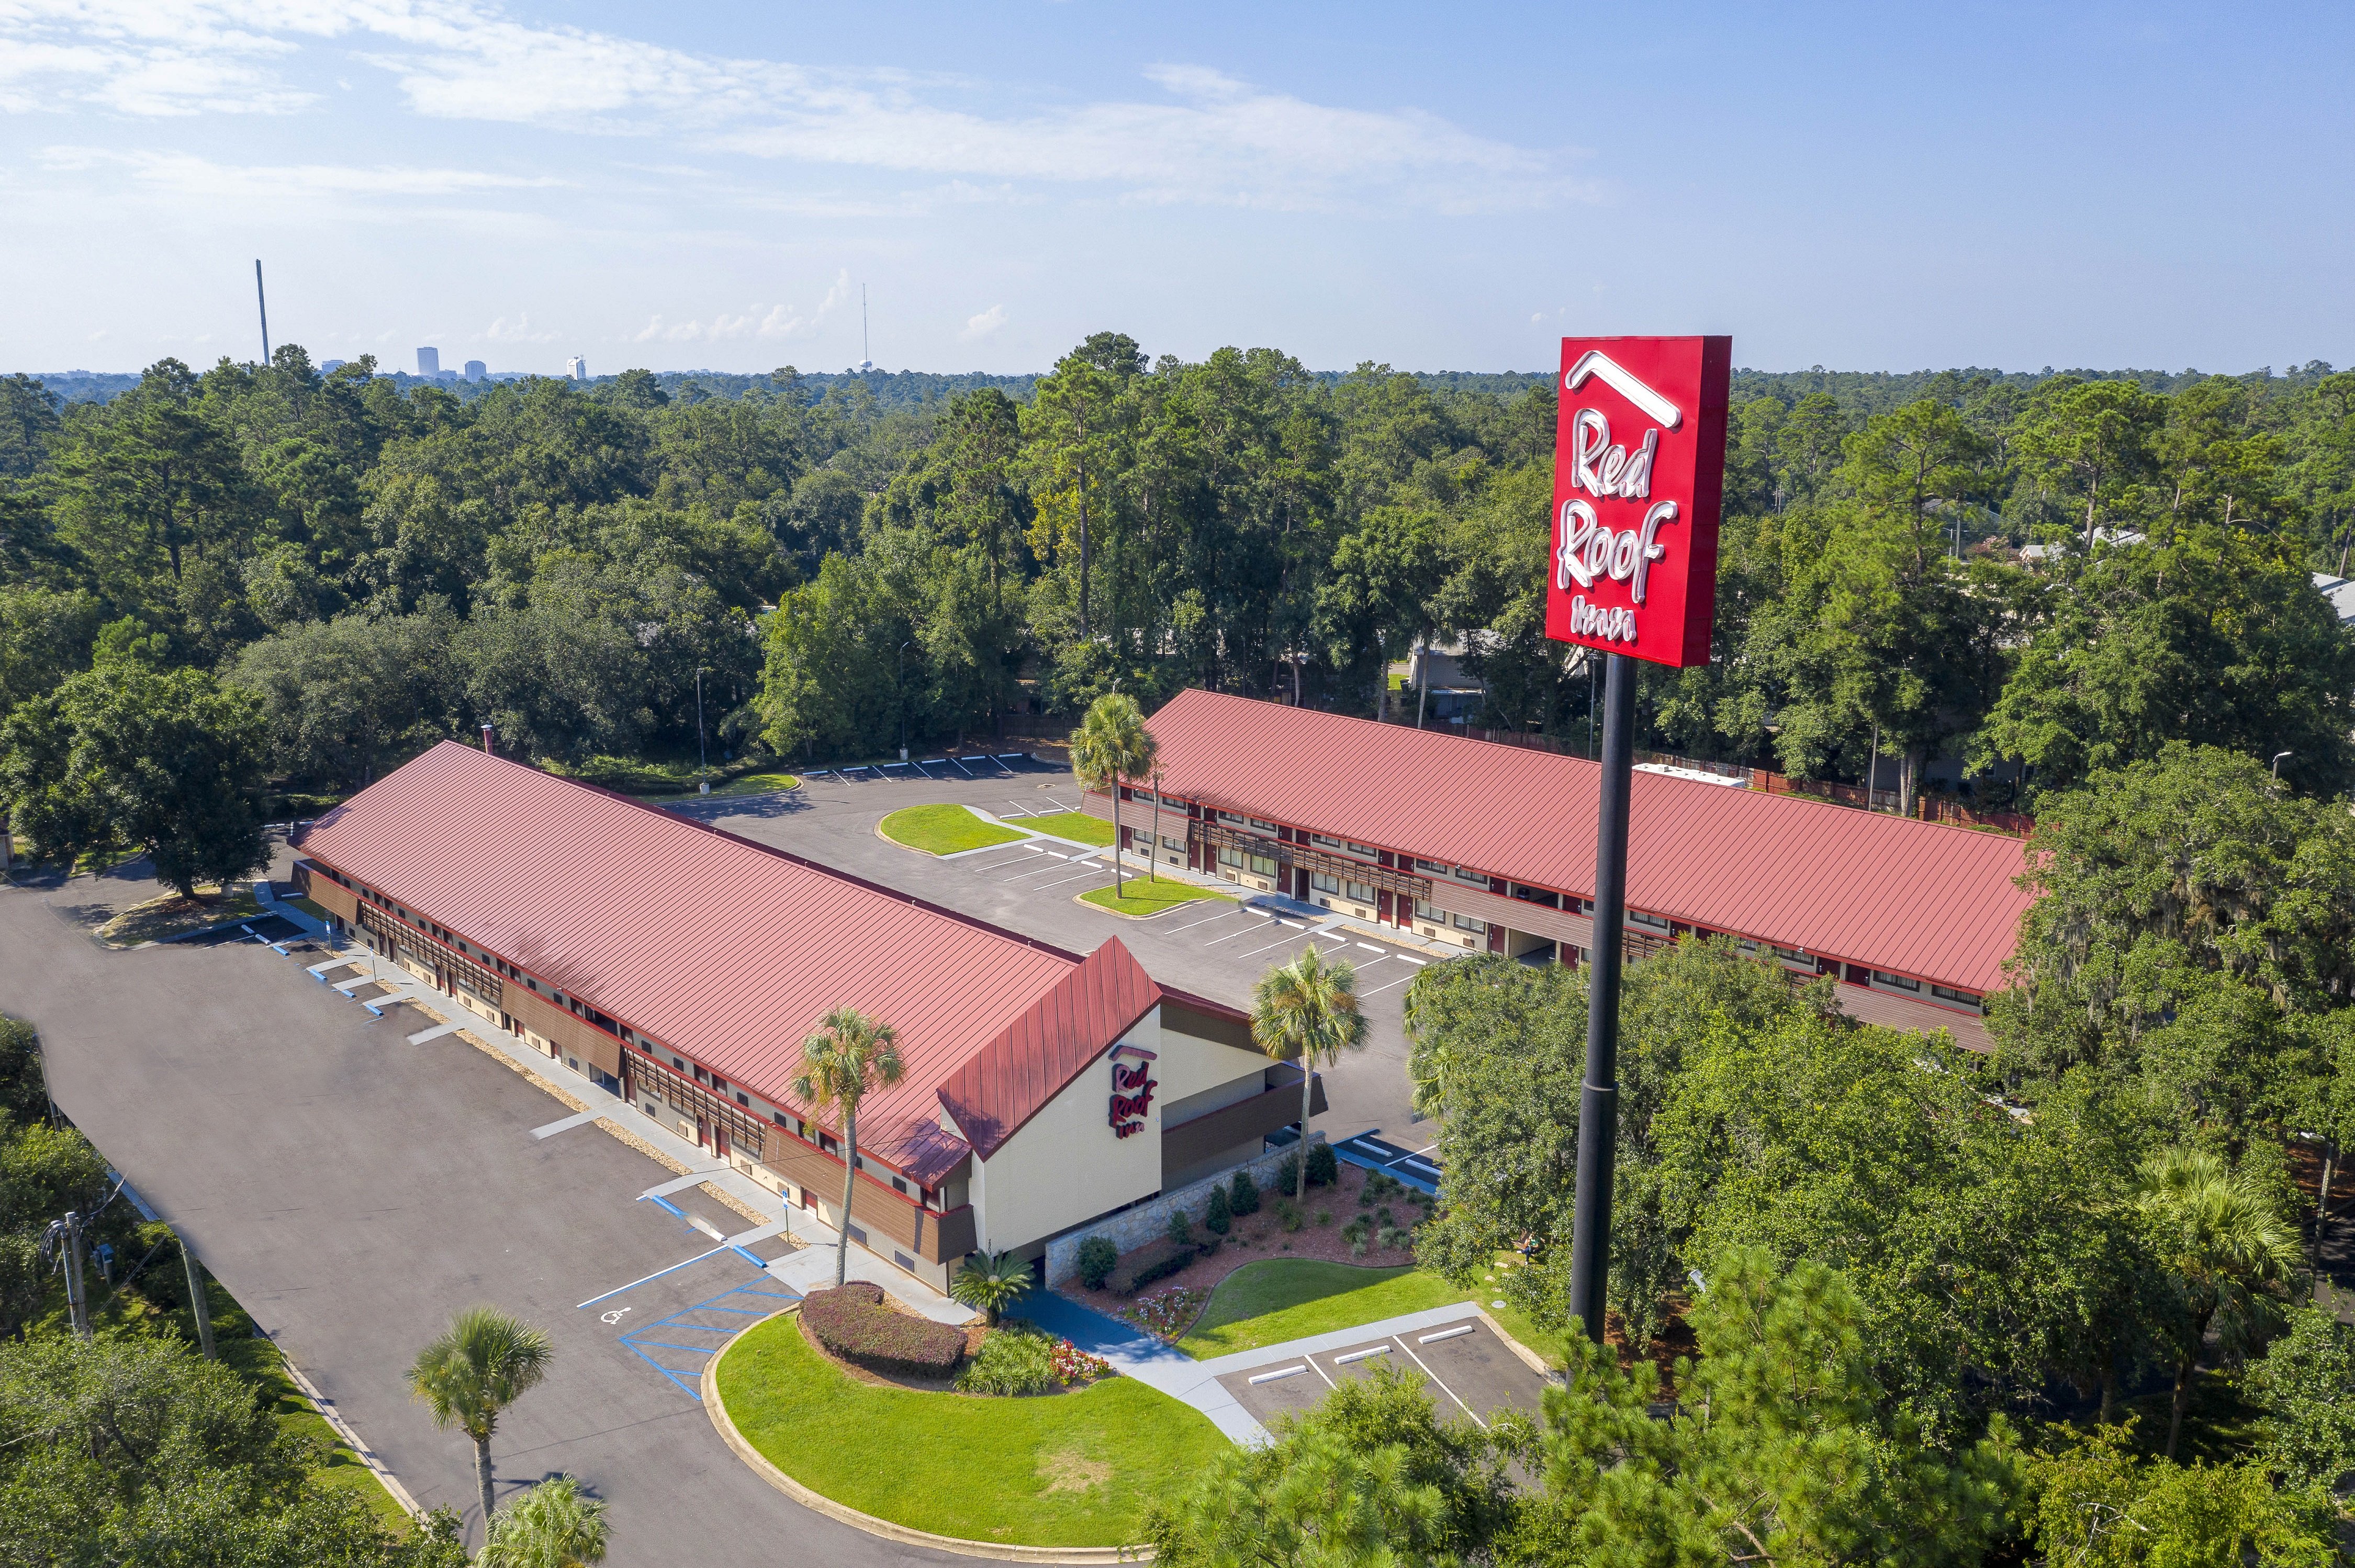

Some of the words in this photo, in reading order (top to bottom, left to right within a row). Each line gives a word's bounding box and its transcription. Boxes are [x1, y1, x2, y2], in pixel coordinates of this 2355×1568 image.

[1572, 408, 1658, 498] Red
[1556, 499, 1678, 604] Roof
[1108, 1079, 1158, 1129] Roof
[1112, 1061, 1149, 1092] Red
